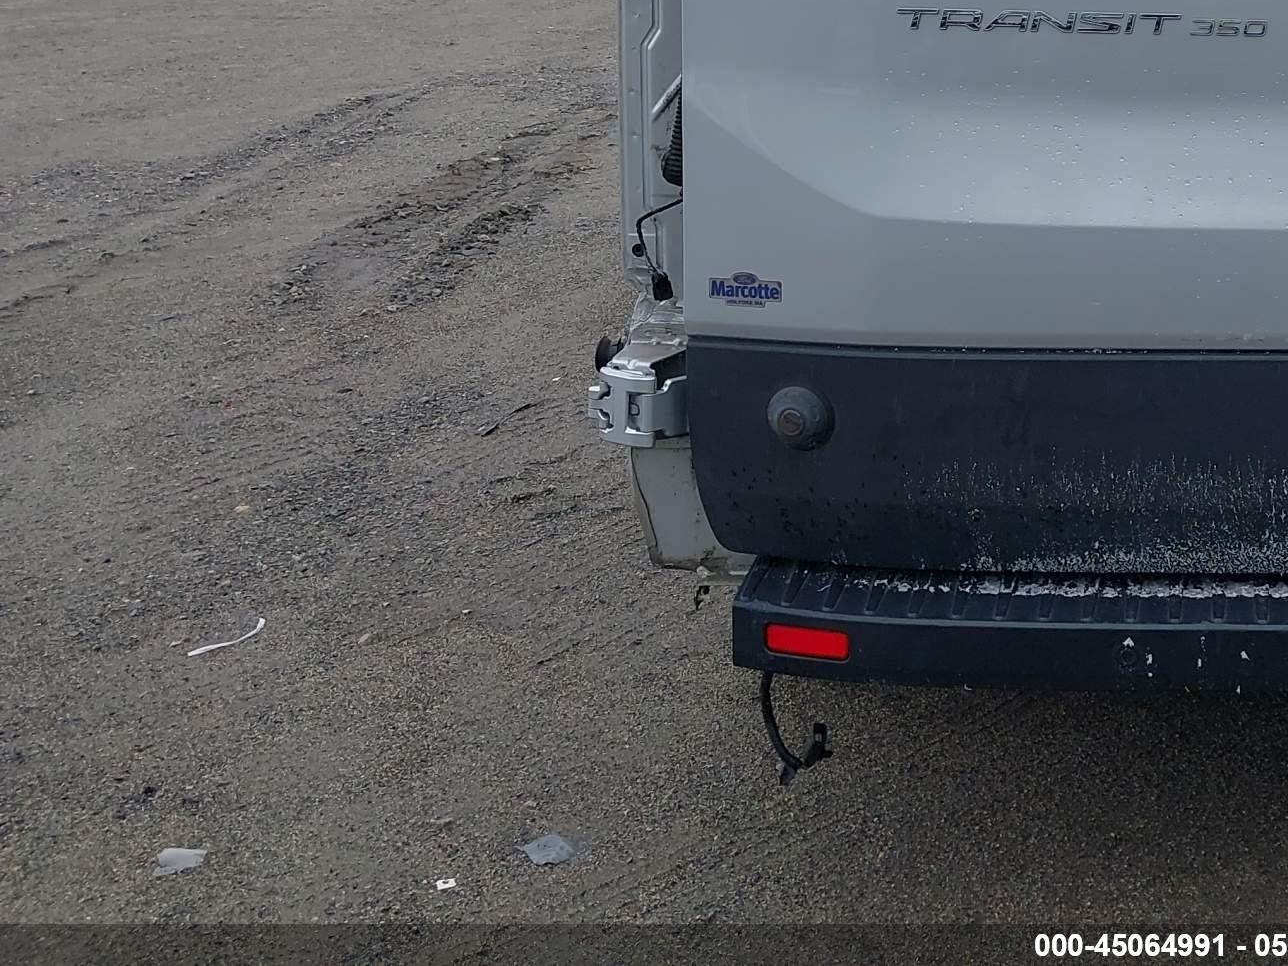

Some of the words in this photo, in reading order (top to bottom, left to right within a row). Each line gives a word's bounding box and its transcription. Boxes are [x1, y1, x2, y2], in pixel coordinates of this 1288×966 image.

[896, 7, 1182, 35] TRANSIT
[1189, 18, 1269, 37] 350
[711, 280, 780, 300] Marcotte
